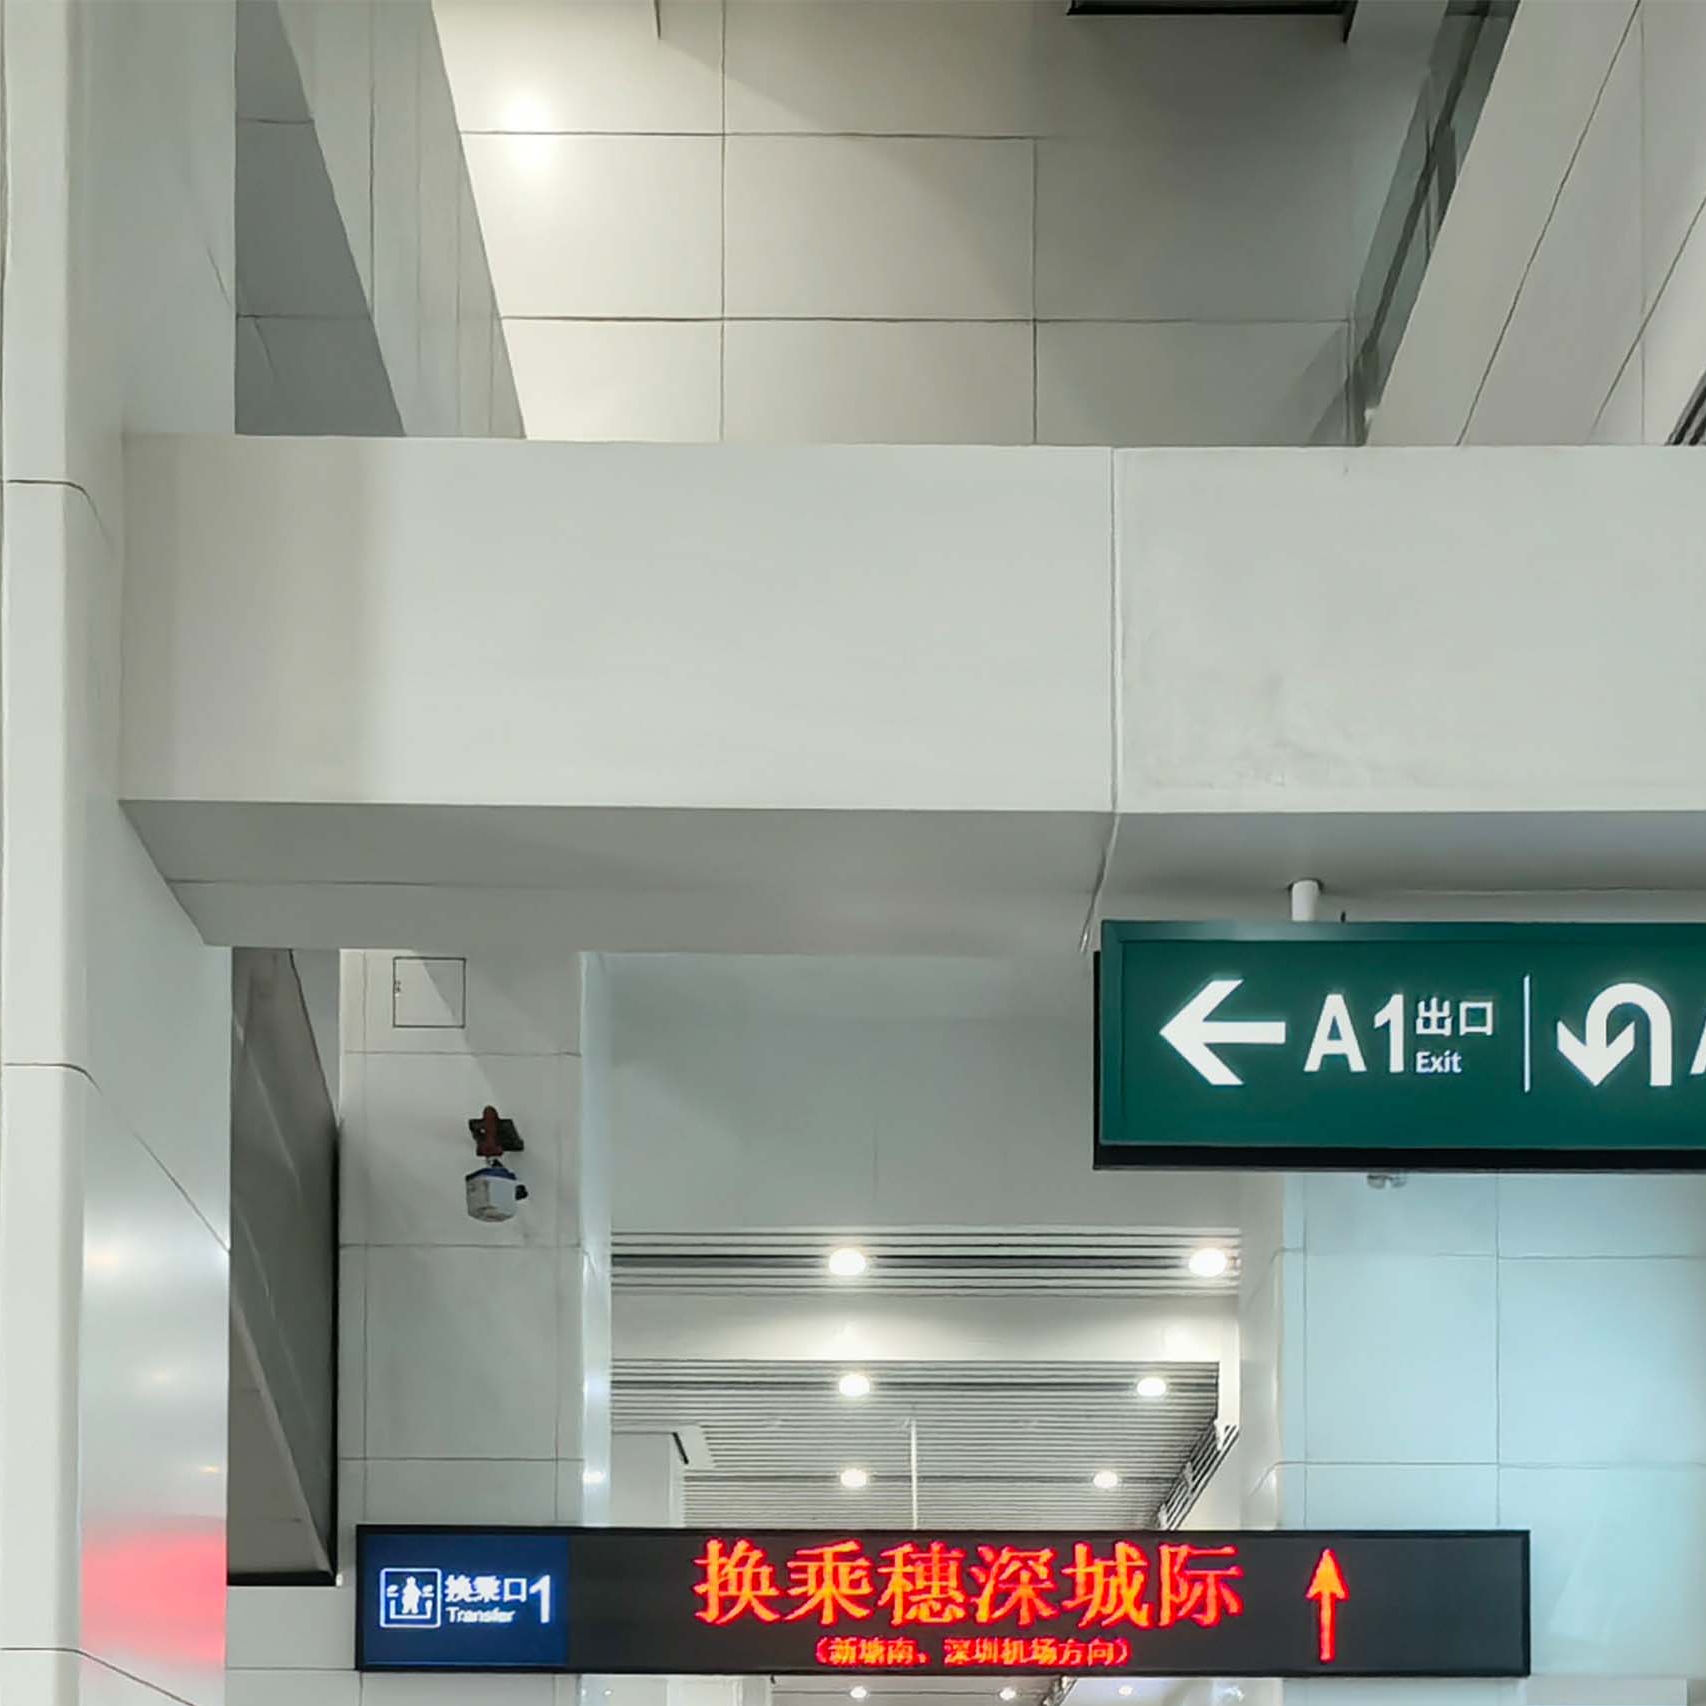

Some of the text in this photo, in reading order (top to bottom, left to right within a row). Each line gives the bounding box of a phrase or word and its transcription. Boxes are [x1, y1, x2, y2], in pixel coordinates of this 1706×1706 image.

[1303, 994, 1493, 1073] A1 出口
[1416, 1050, 1463, 1074] Exit
[692, 1537, 1245, 1629] 换乘穗深城际
[445, 1607, 517, 1624] Transfer
